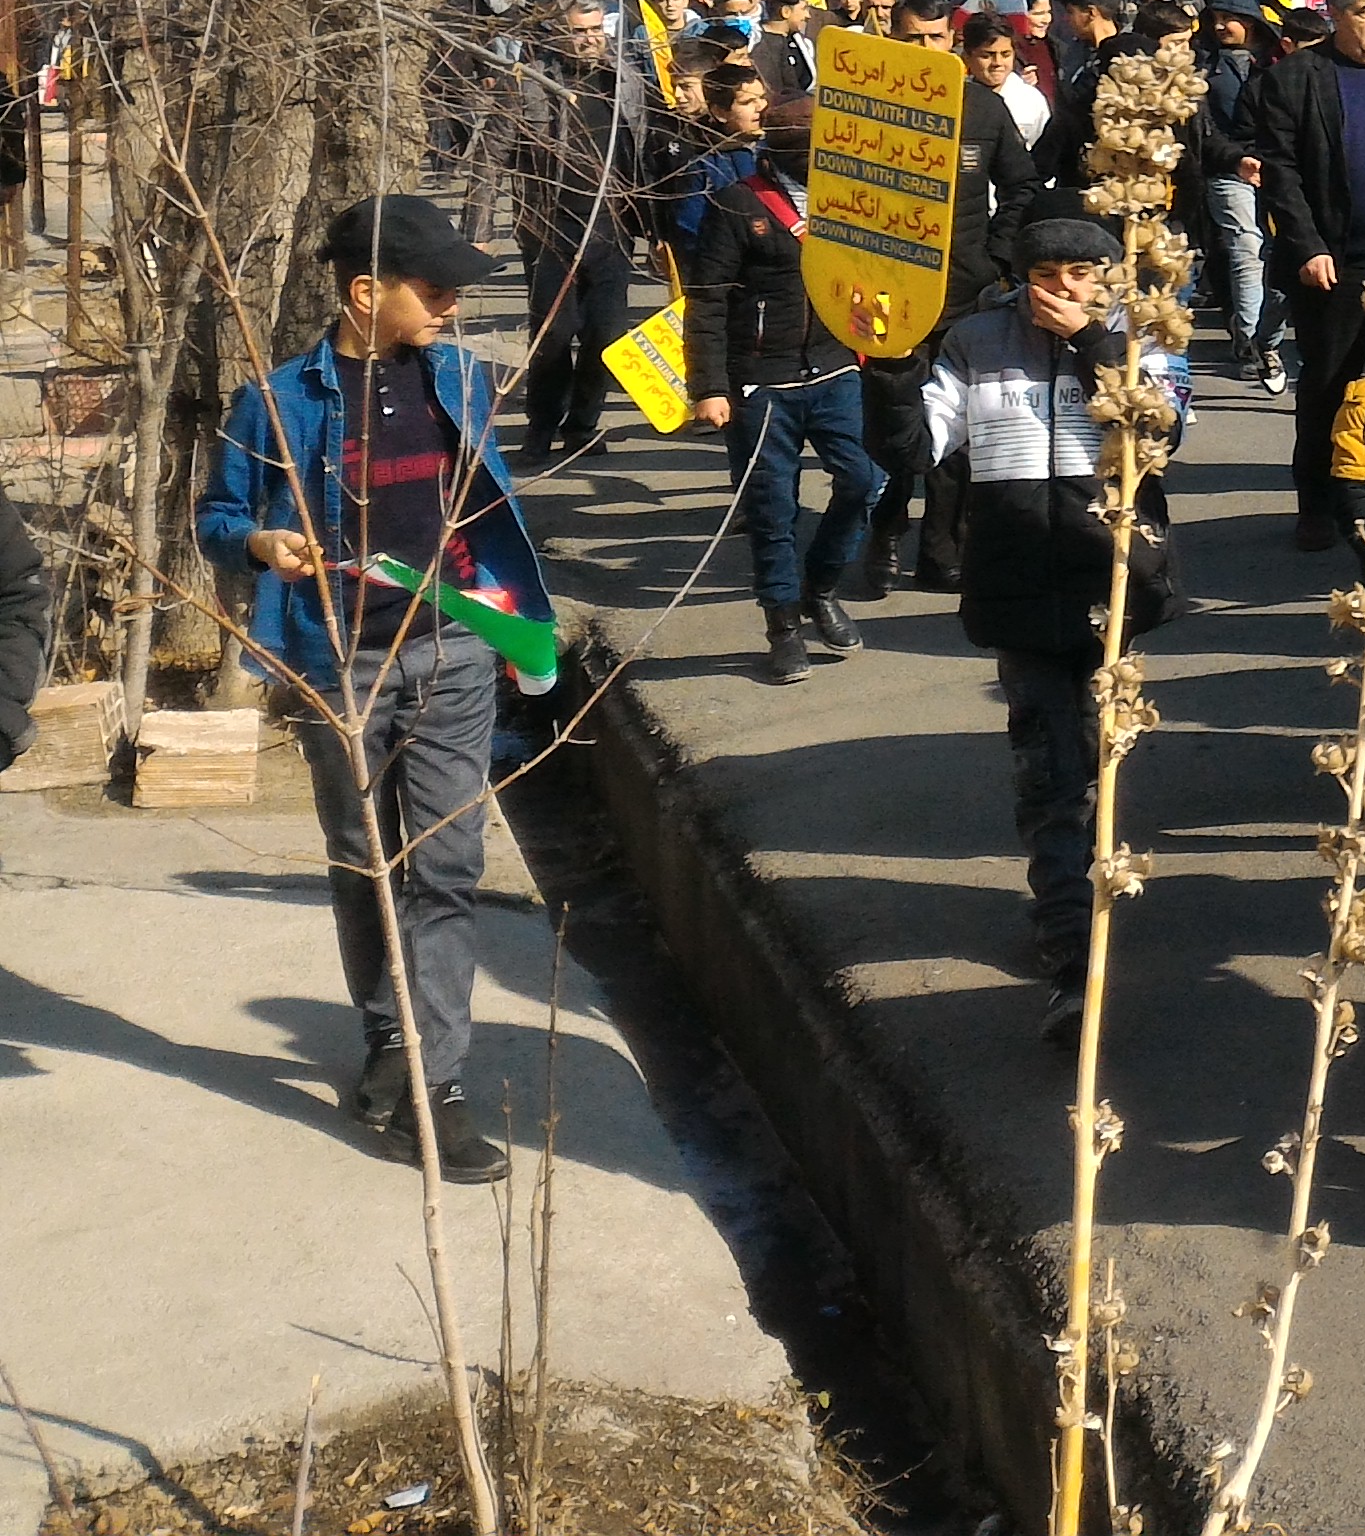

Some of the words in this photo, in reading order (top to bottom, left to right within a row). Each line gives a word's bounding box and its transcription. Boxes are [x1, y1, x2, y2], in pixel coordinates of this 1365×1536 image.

[886, 73, 906, 97] بر
[910, 66, 948, 103] مرگ
[823, 88, 868, 114] DOWN
[871, 99, 907, 126] WITH
[885, 143, 905, 167] بر
[909, 138, 945, 172] مرگ
[817, 152, 858, 177] DOWN
[861, 163, 896, 186] WITH
[899, 172, 946, 199] ISRAEL
[816, 189, 880, 220] انگلیس
[881, 213, 900, 235] بر
[904, 205, 941, 241] مرگ
[810, 218, 848, 240] DOWN
[850, 229, 880, 249] WITH
[882, 238, 941, 265] ENGLAND
